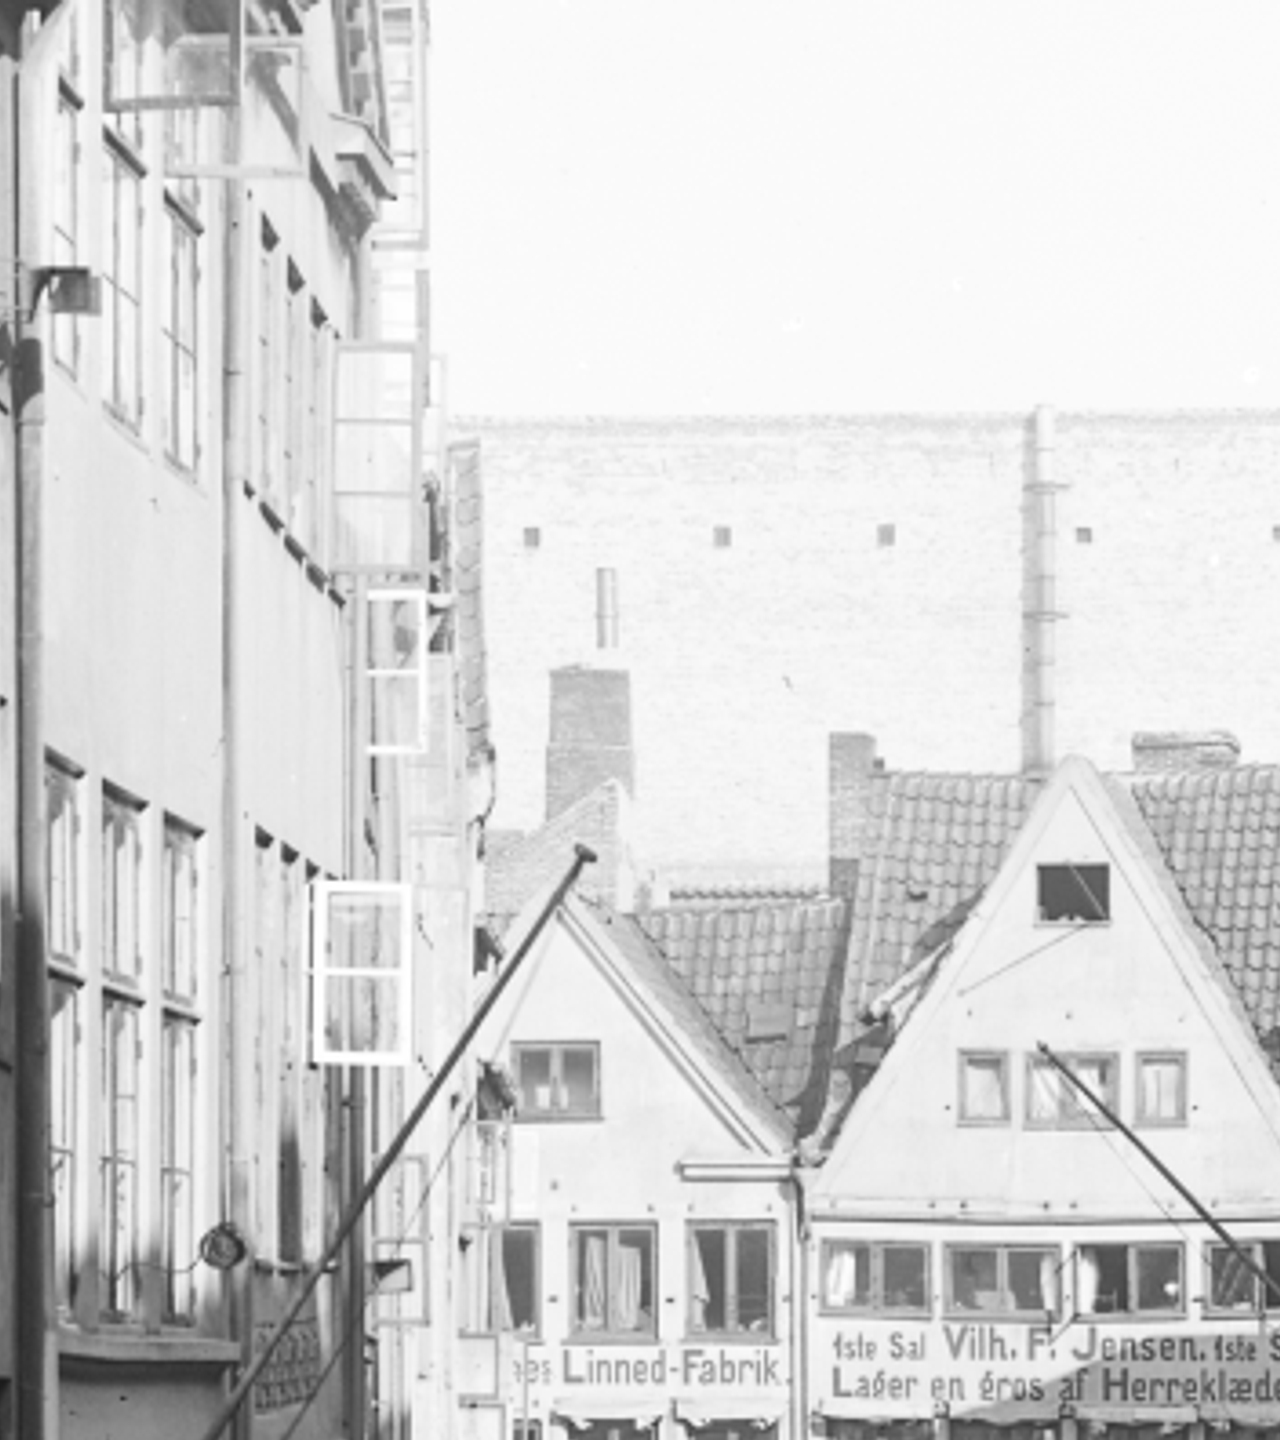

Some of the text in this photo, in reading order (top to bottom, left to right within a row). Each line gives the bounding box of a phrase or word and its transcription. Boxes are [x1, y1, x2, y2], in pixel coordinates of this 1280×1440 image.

[889, 1330, 926, 1361] Sal
[832, 1366, 918, 1399] Lager
[931, 1376, 965, 1401] en
[979, 1370, 1045, 1401] gros
[1058, 1366, 1088, 1401] af
